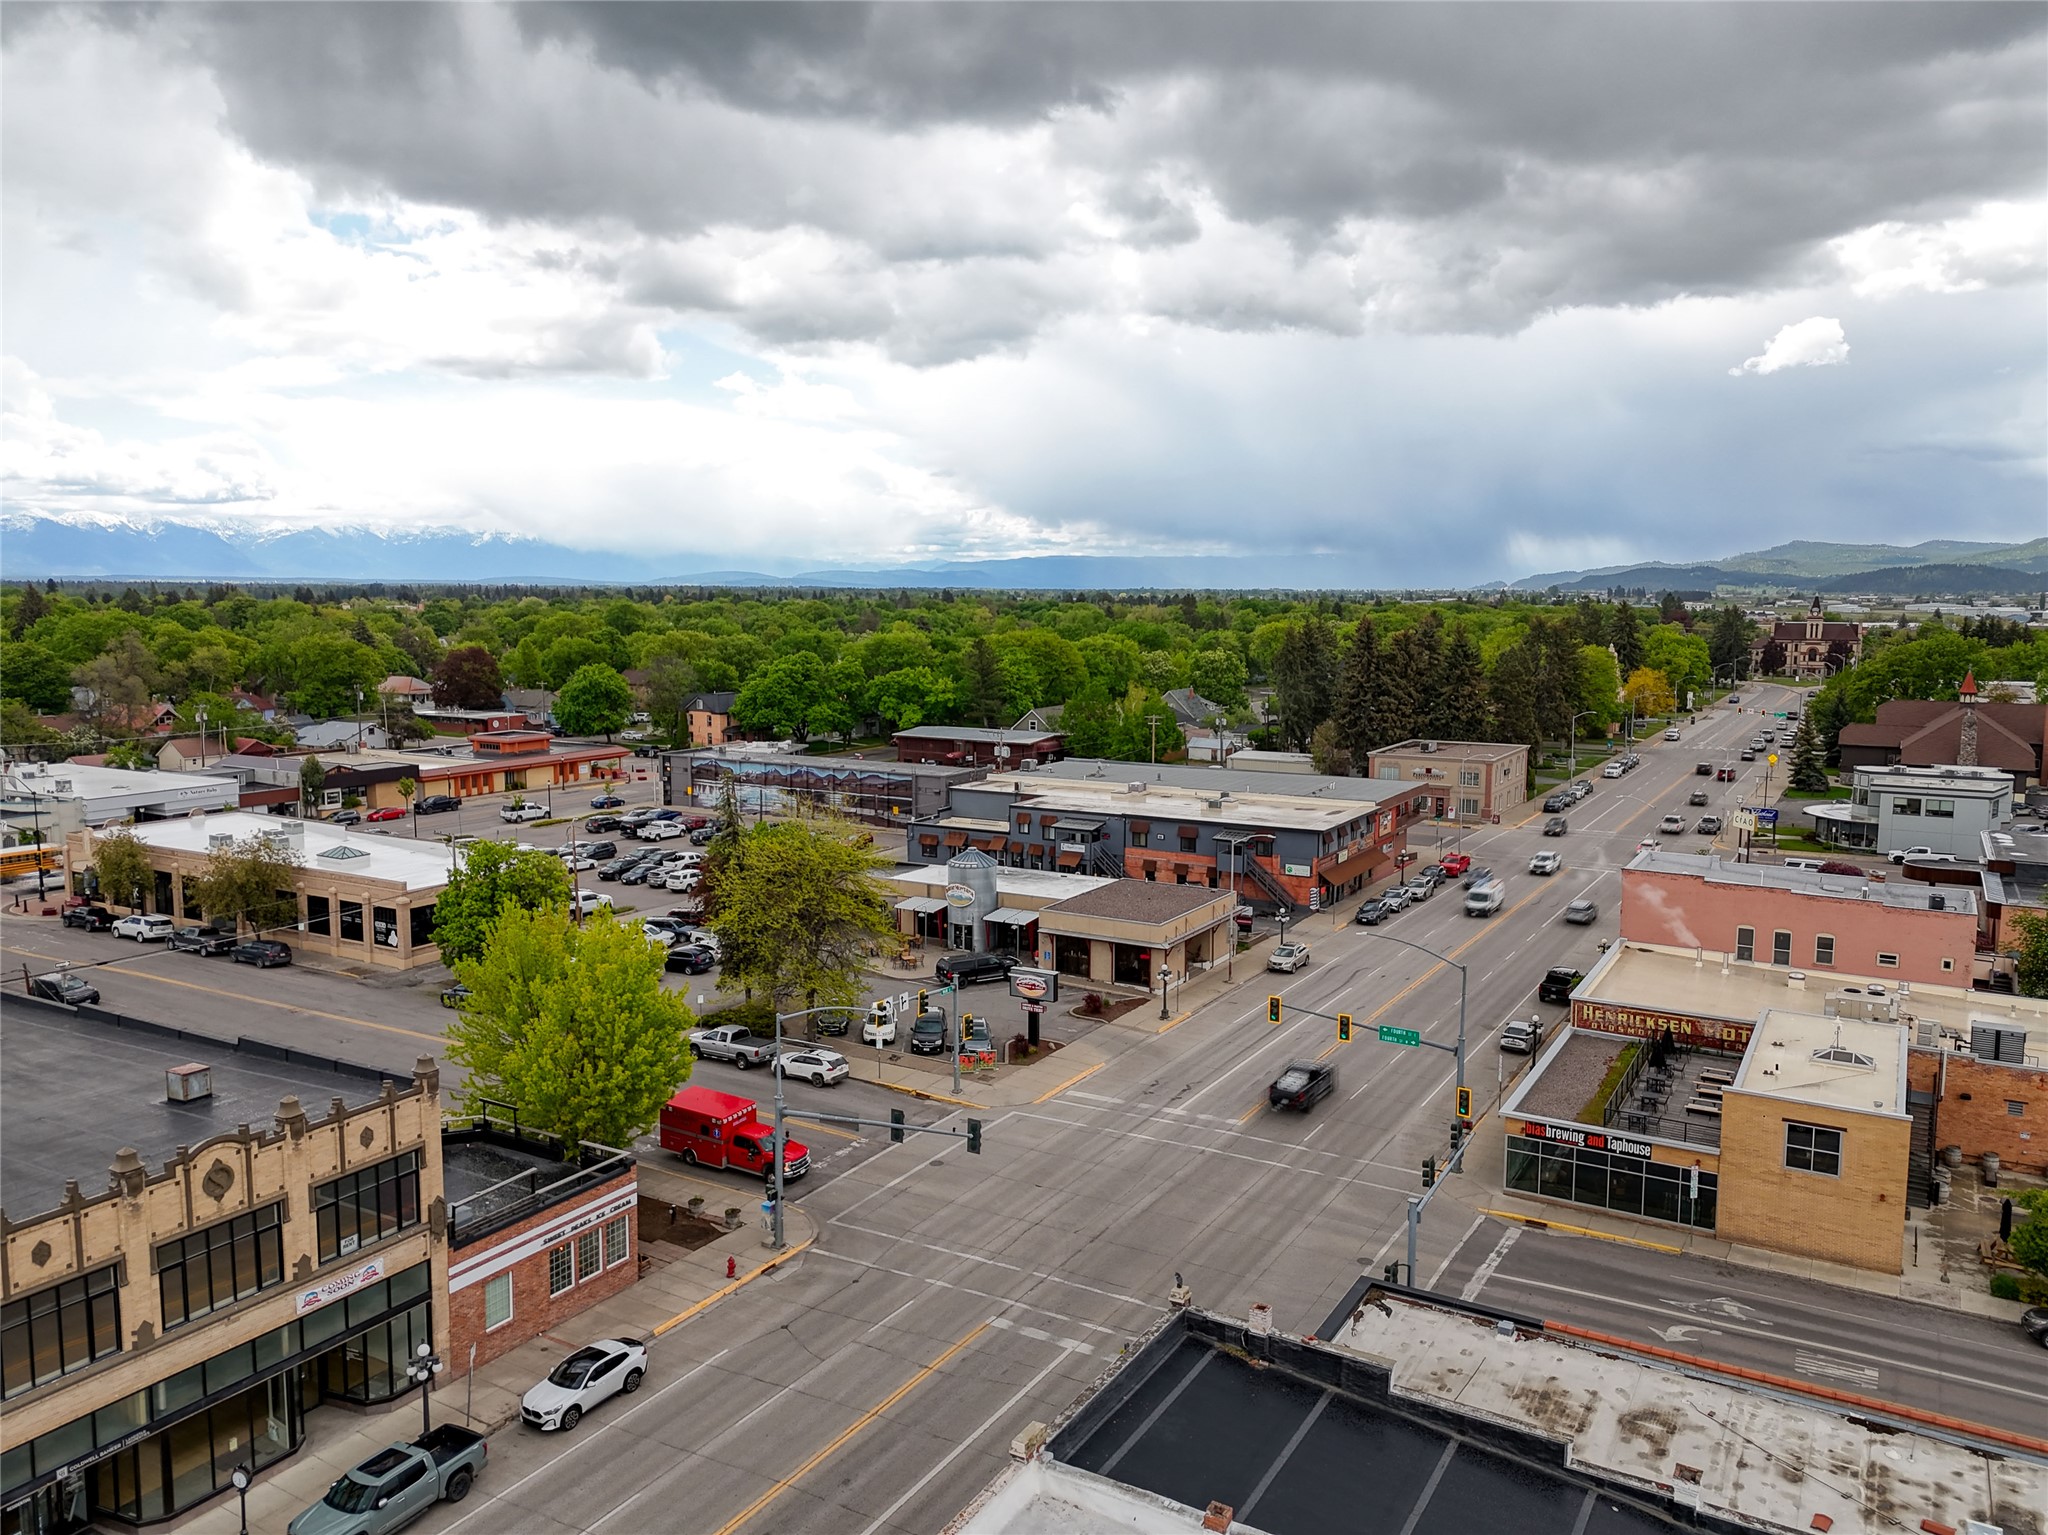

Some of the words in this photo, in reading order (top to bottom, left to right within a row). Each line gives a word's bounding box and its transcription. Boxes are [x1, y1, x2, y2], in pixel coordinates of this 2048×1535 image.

[1583, 1005, 1691, 1035] HENRICKSEN
[1587, 1134, 1604, 1148] and
[1606, 1136, 1651, 1156] Taphouse
[542, 1229, 566, 1246] SWEET
[570, 1217, 592, 1233] PEAKS
[595, 1210, 606, 1220] ICE
[609, 1198, 632, 1213] CREAM
[342, 1240, 355, 1249] RENT
[321, 1271, 361, 1293] COMING
[327, 1279, 355, 1296] SOON
[69, 1454, 100, 1472] COLDWELL
[99, 1442, 122, 1457] BANKER
